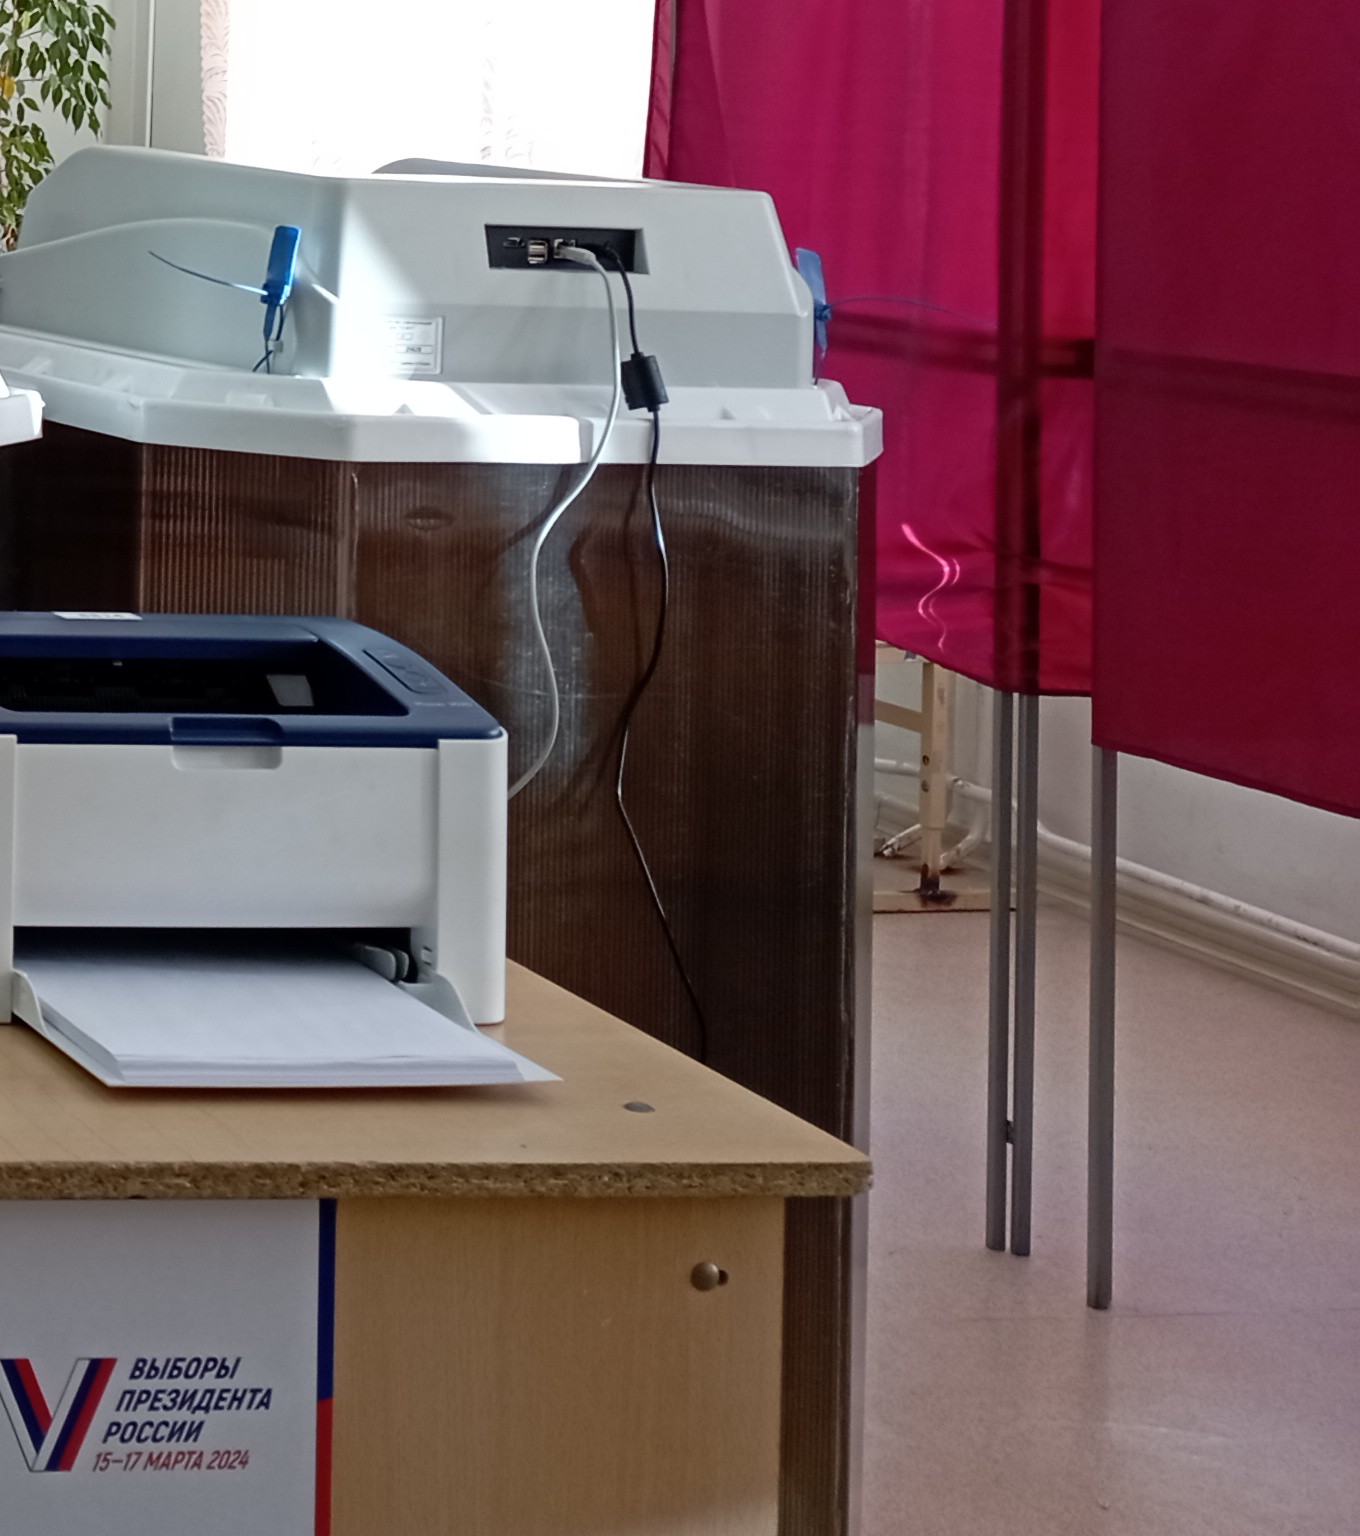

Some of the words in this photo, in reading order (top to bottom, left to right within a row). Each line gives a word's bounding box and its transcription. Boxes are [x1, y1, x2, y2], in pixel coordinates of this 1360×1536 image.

[129, 1356, 242, 1380] ВЫБОРЫ
[115, 1387, 273, 1414] ПРЕЗИДЕНТА
[102, 1419, 205, 1444] РОССИИ
[142, 1450, 204, 1471] МАРТА
[206, 1449, 250, 1470] 2024
